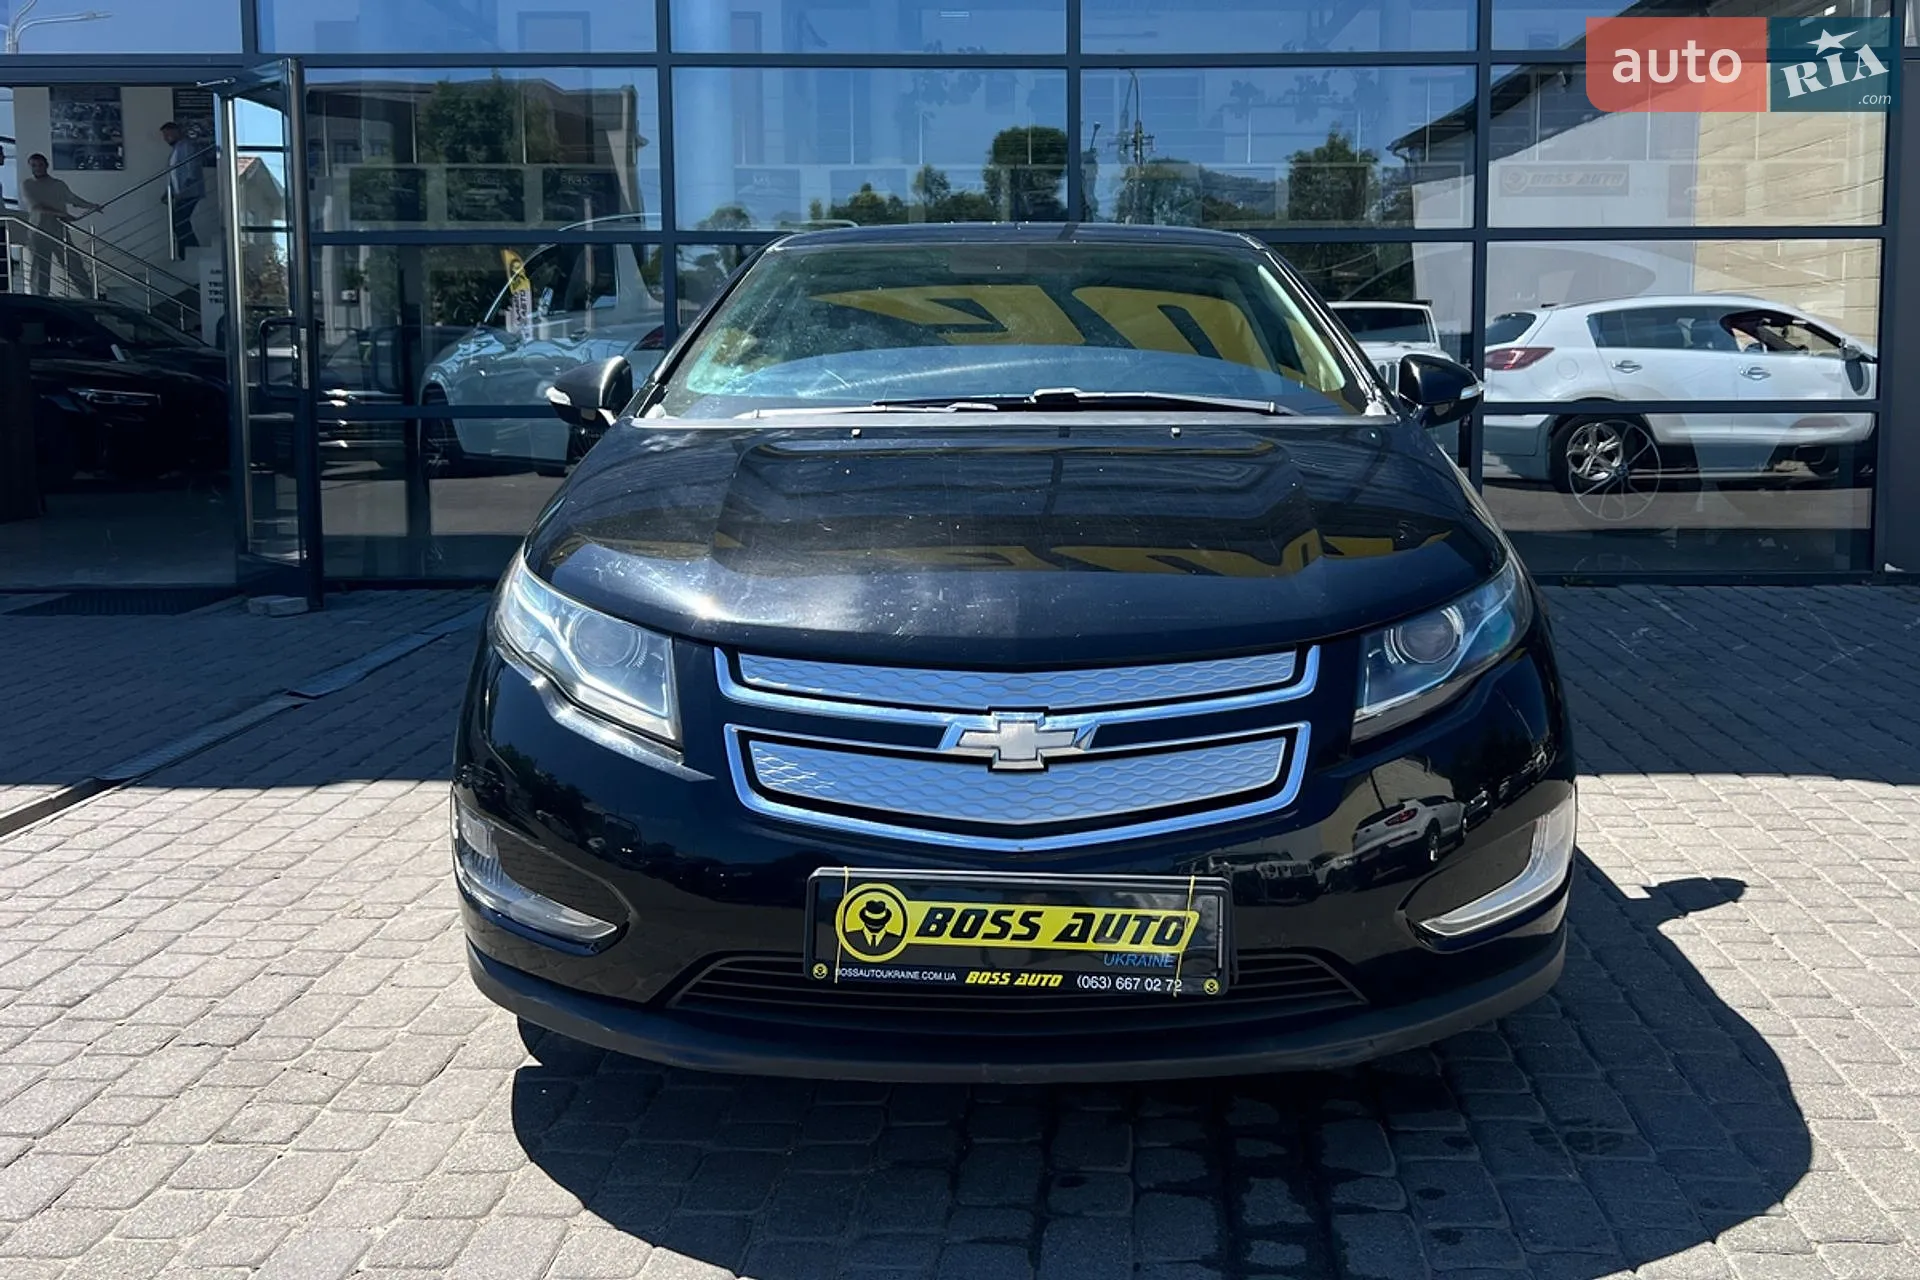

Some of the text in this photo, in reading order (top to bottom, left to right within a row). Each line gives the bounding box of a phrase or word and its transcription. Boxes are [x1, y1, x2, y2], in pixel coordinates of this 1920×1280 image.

[915, 907, 1189, 946] BOSS AUTO
[1103, 953, 1178, 968] UKRAINE
[965, 971, 1063, 987] BOSS AUTO
[1077, 975, 1182, 992] (063) 667 02 72
